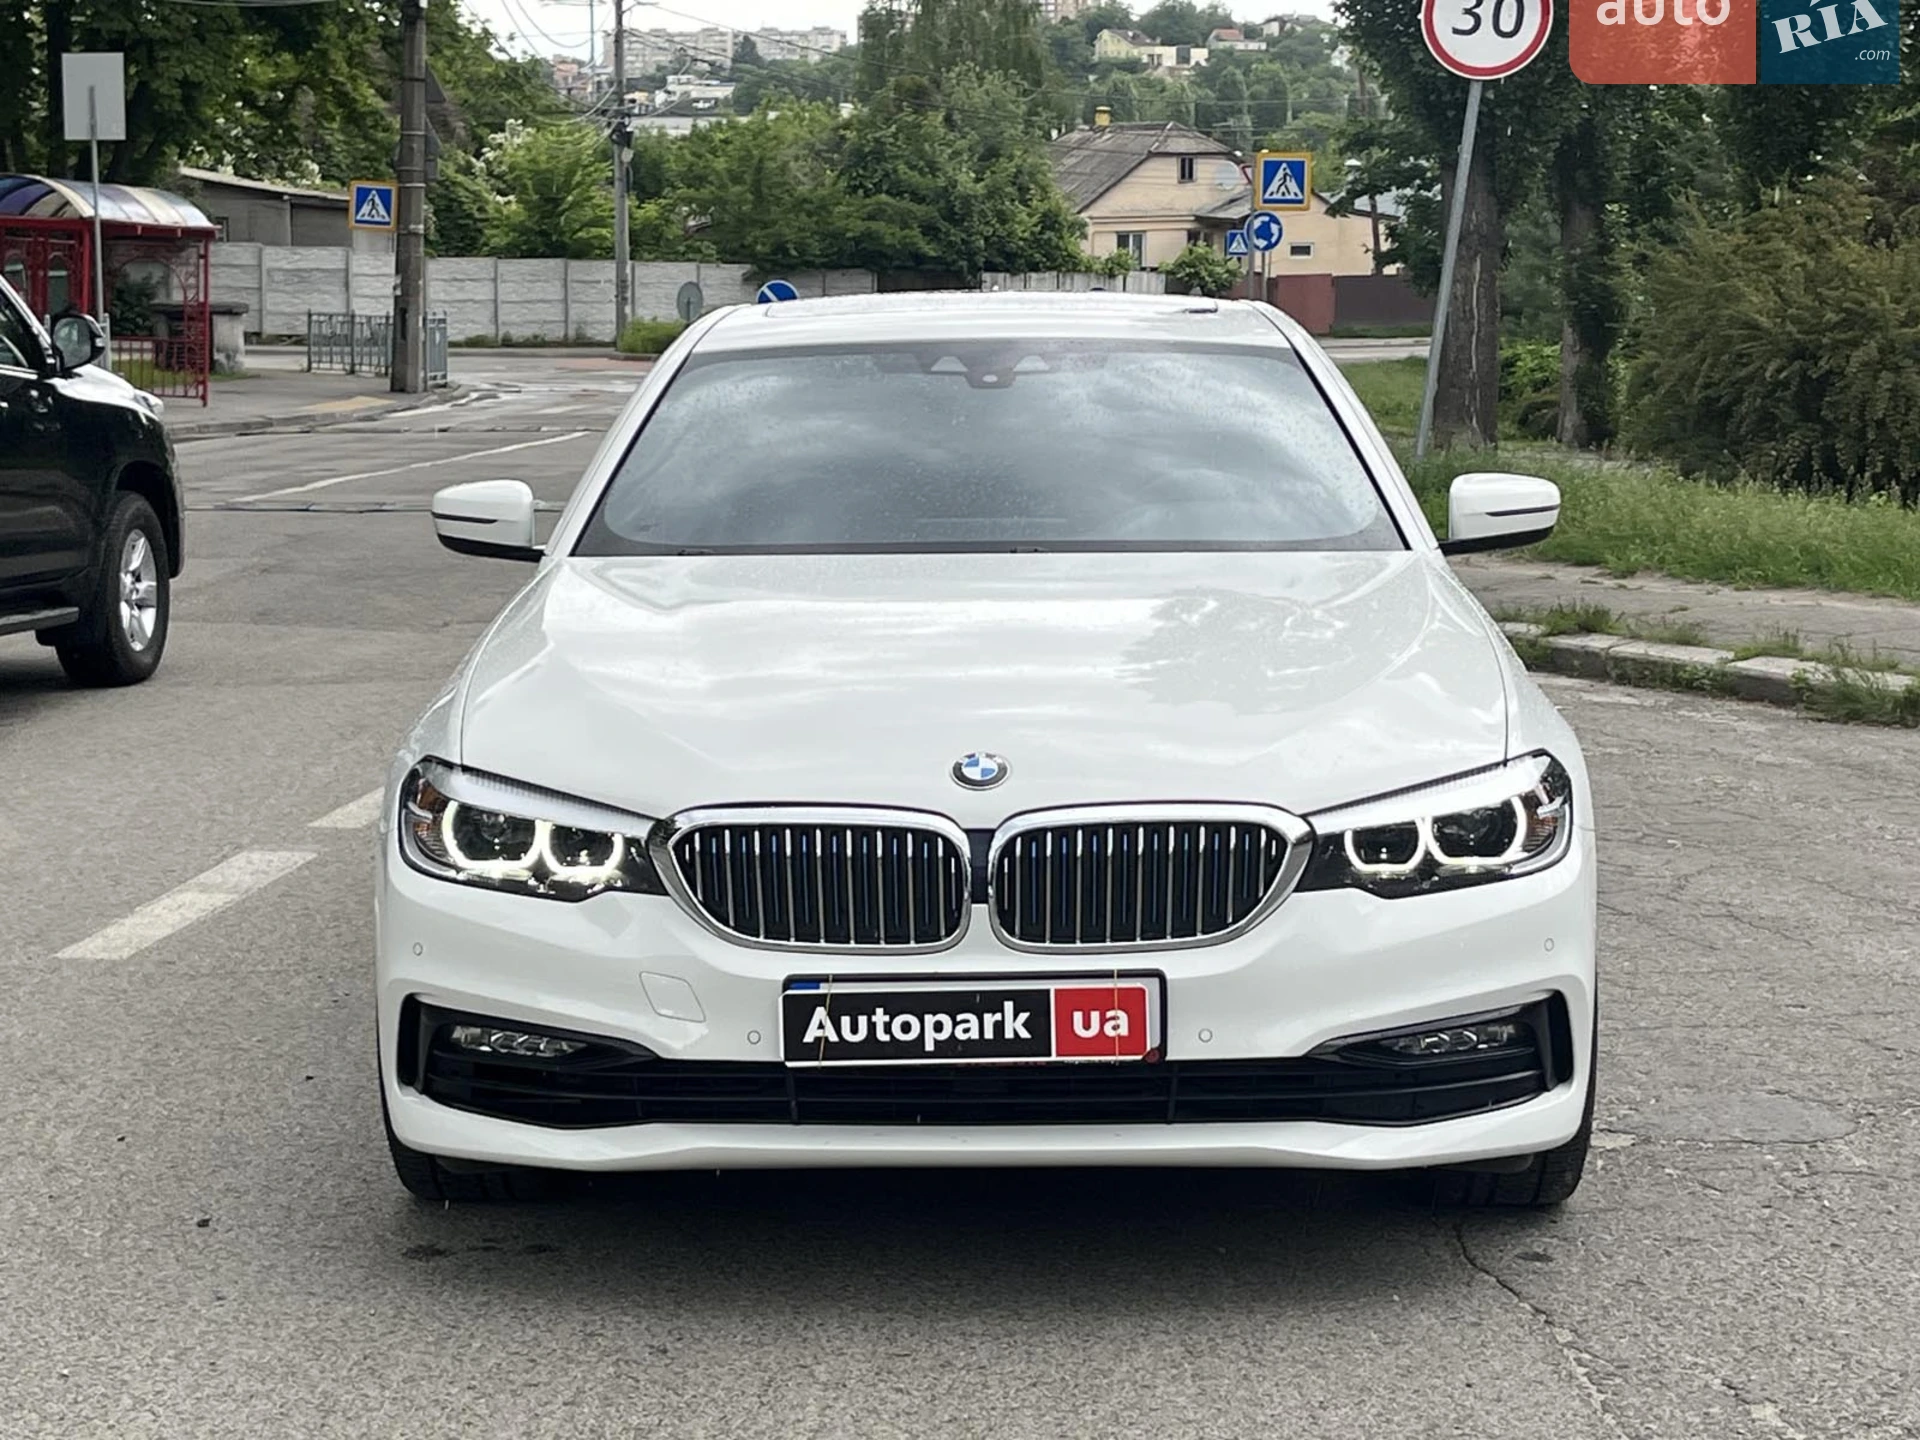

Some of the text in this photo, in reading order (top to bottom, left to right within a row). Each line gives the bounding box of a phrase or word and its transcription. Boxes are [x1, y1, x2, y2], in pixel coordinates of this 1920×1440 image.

[1452, 0, 1524, 38] 30
[802, 1001, 1129, 1052] Autopark ua
